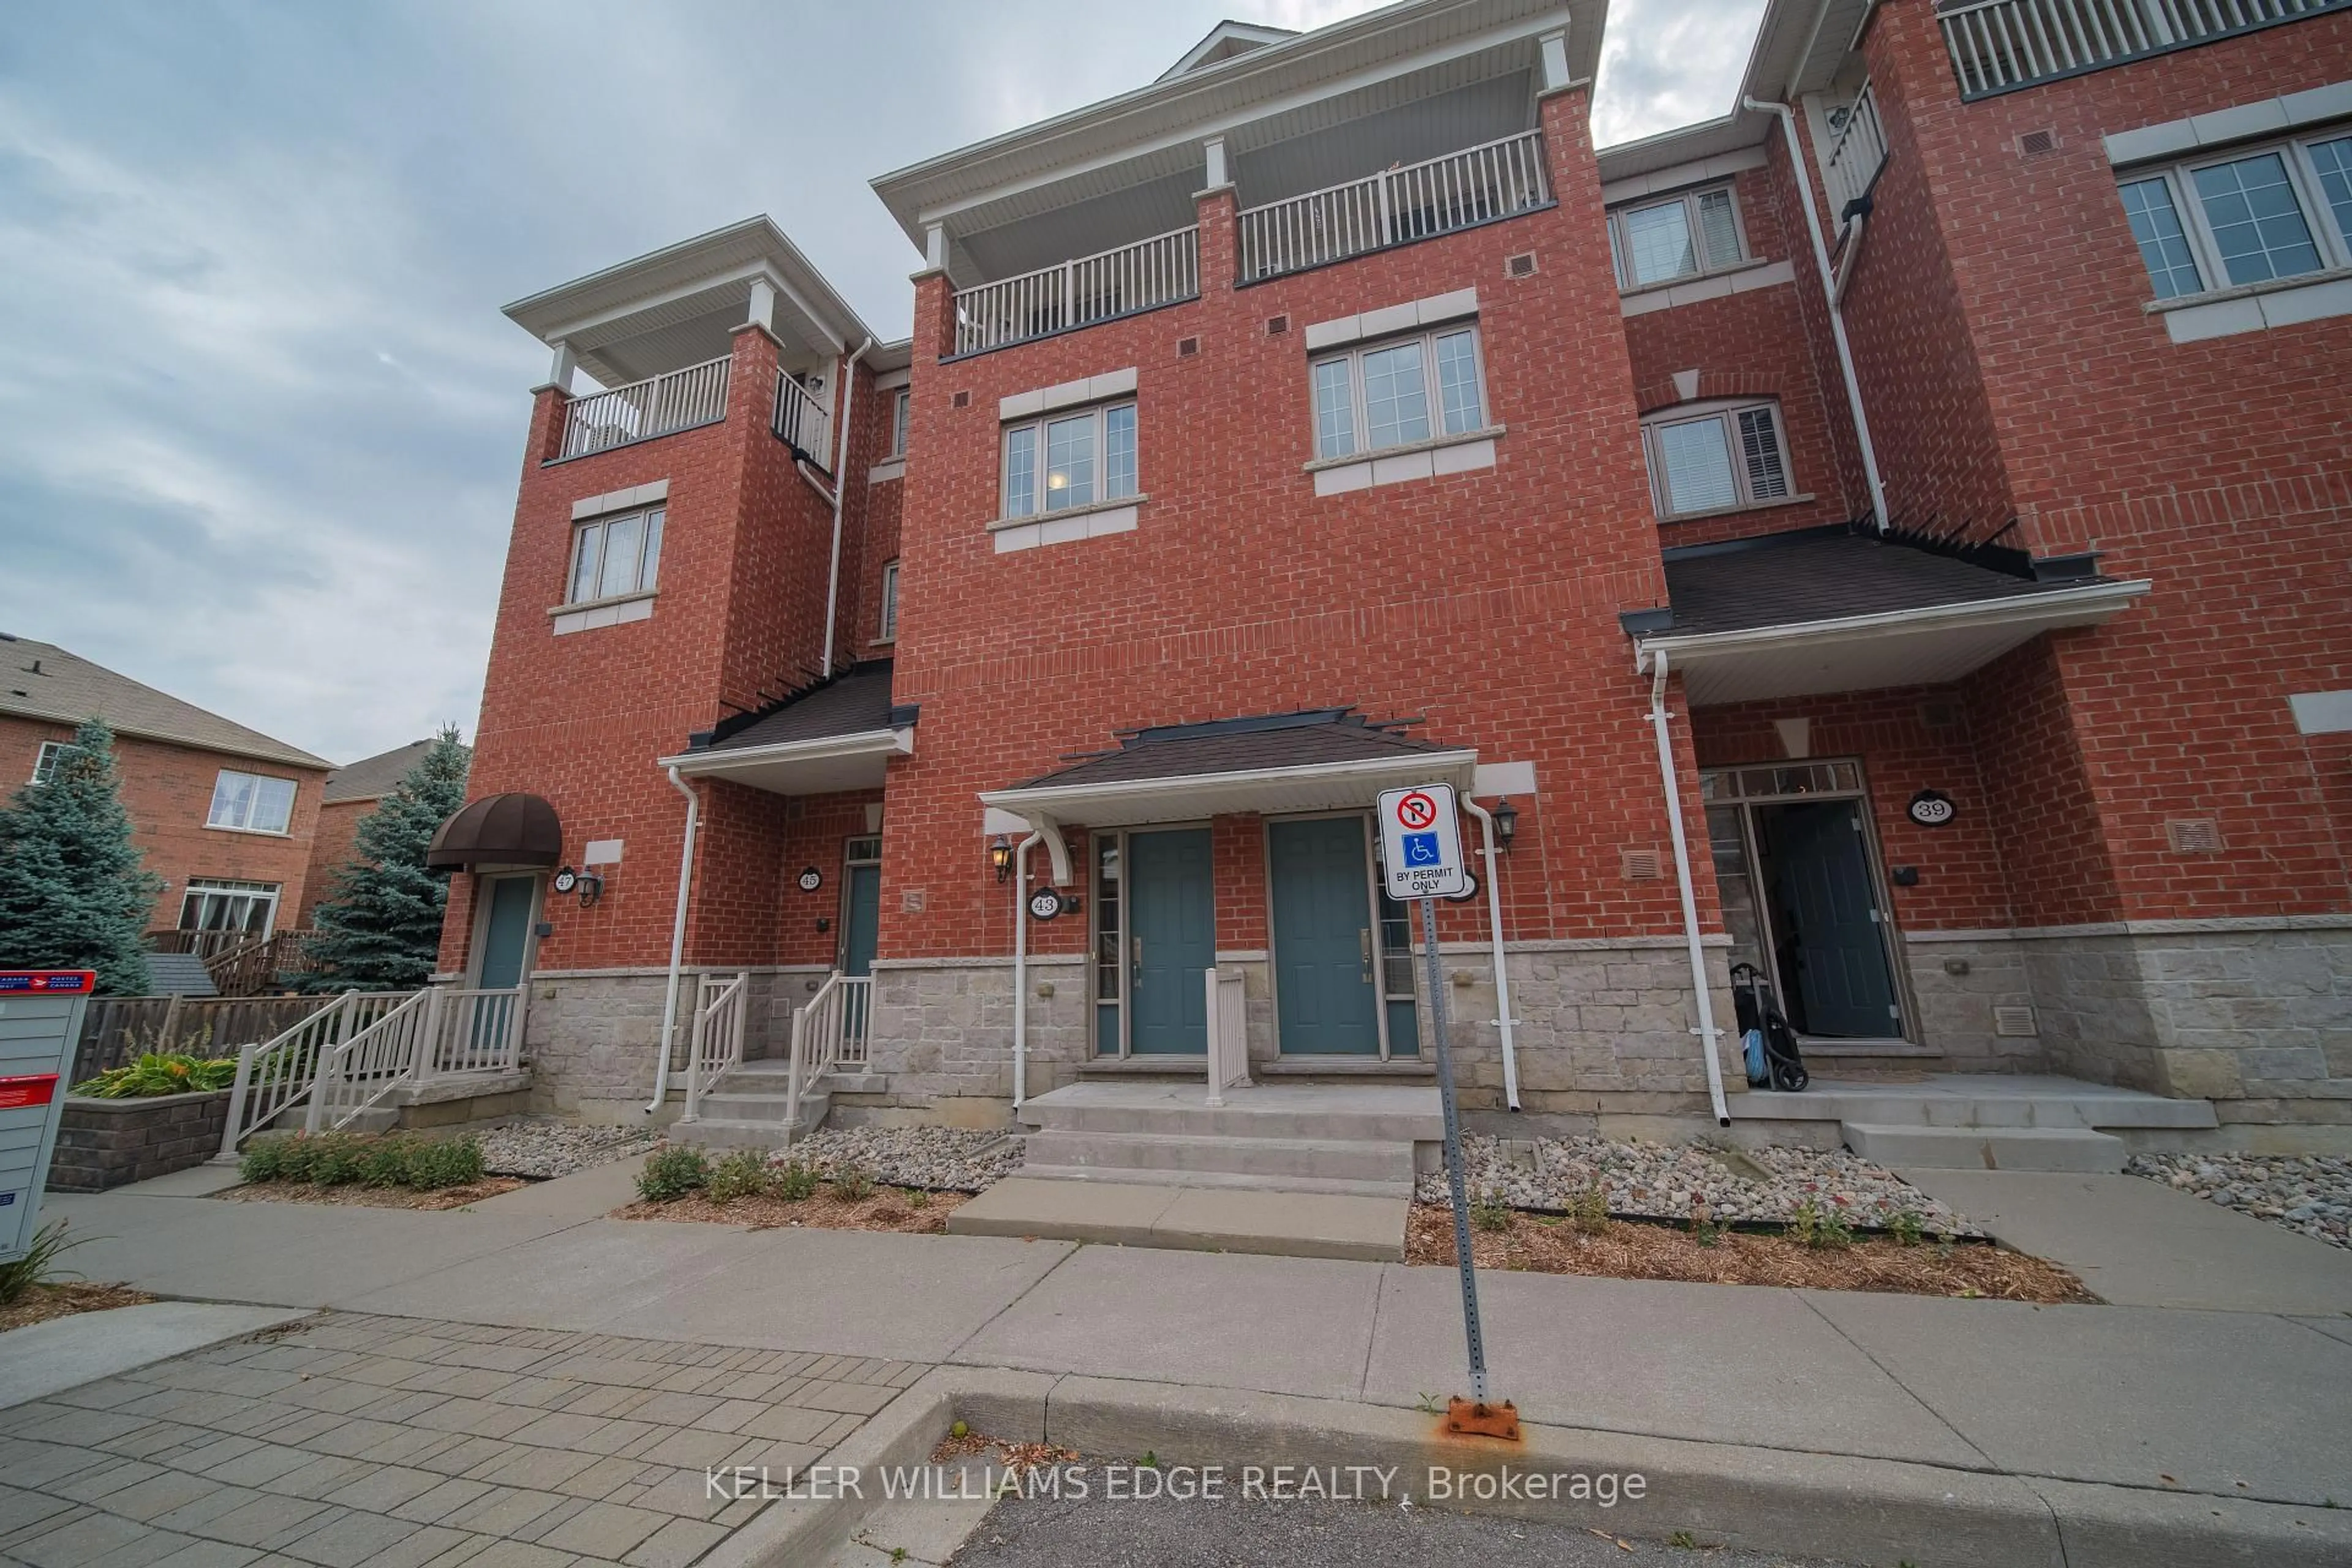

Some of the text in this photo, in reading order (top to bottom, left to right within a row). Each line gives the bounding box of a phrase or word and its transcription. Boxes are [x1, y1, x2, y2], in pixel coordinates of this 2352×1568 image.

[1918, 802, 1945, 816] 39
[1396, 867, 1453, 881] BY PERMIT
[558, 876, 571, 886] 47
[802, 875, 817, 886] 45
[1412, 880, 1439, 891] ONLY
[1035, 899, 1054, 911] 43
